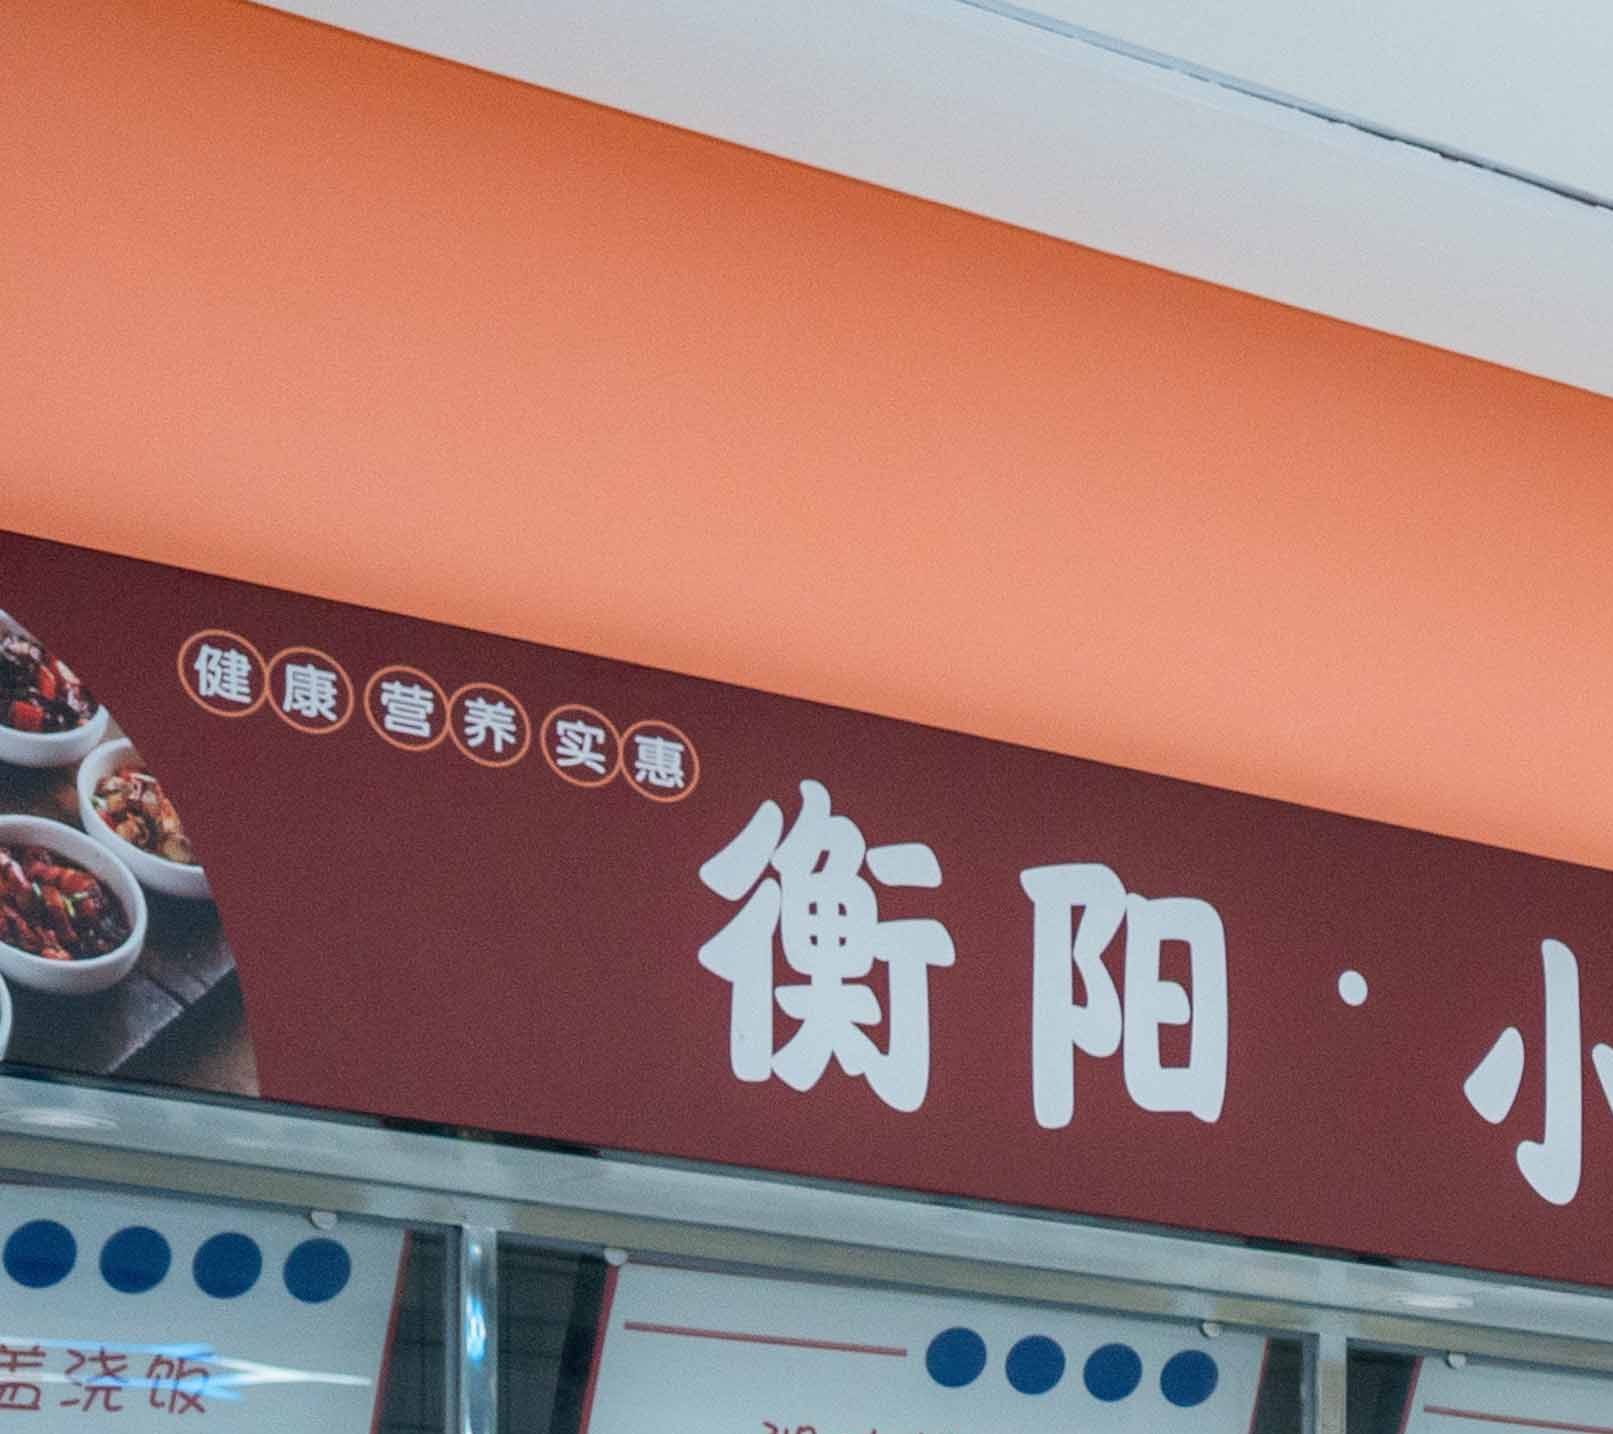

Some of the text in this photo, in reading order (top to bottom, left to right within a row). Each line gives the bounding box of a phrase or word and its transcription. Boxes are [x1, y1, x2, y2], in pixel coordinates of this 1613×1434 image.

[192, 641, 689, 791] 健康营养实惠
